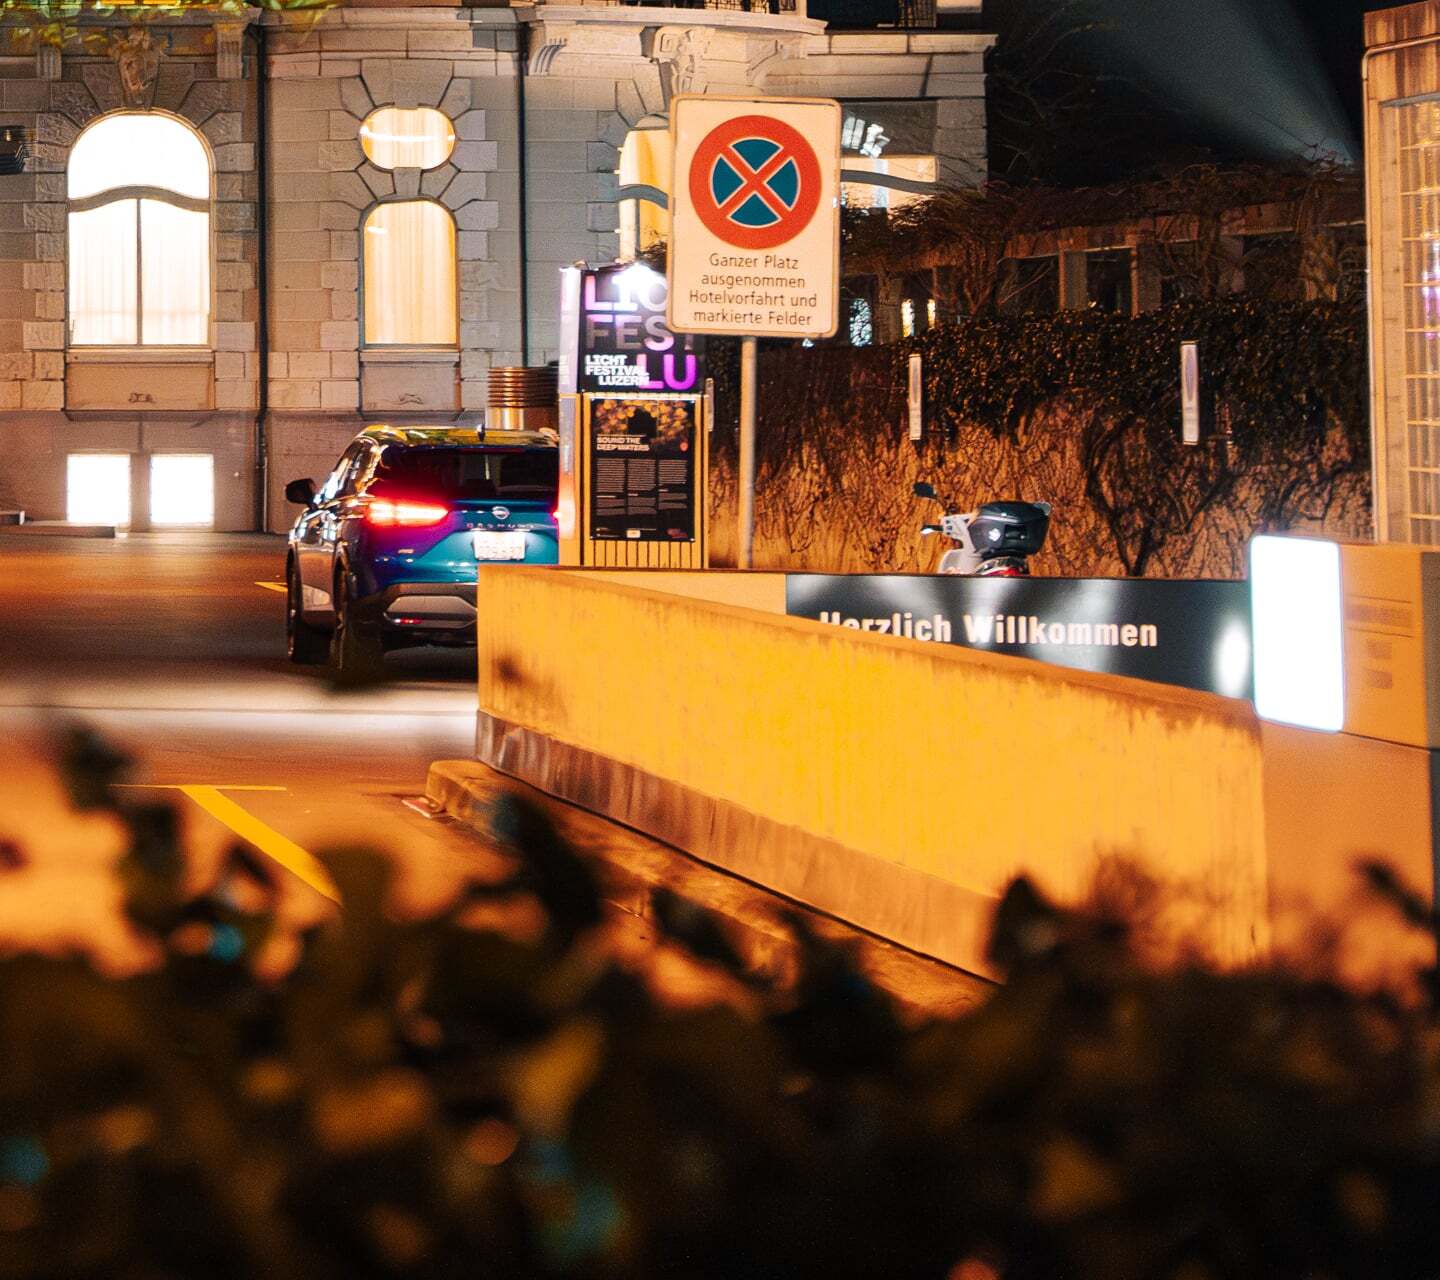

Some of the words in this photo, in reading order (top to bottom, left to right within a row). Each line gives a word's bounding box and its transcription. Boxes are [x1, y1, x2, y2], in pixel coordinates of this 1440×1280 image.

[709, 252, 759, 268] Ganzer
[764, 255, 799, 270] Platz
[701, 274, 806, 289] ausgenommen
[689, 290, 785, 307] Hotelvorfahrt
[790, 293, 818, 308] und
[693, 308, 762, 324] markierte
[768, 311, 813, 327] Felder
[585, 313, 694, 351] FES
[585, 354, 628, 366] LICHT
[585, 365, 649, 376] FESTIVAL
[636, 353, 697, 391] LU
[598, 375, 650, 386] LUZERN
[963, 614, 1158, 648] Willkommen
